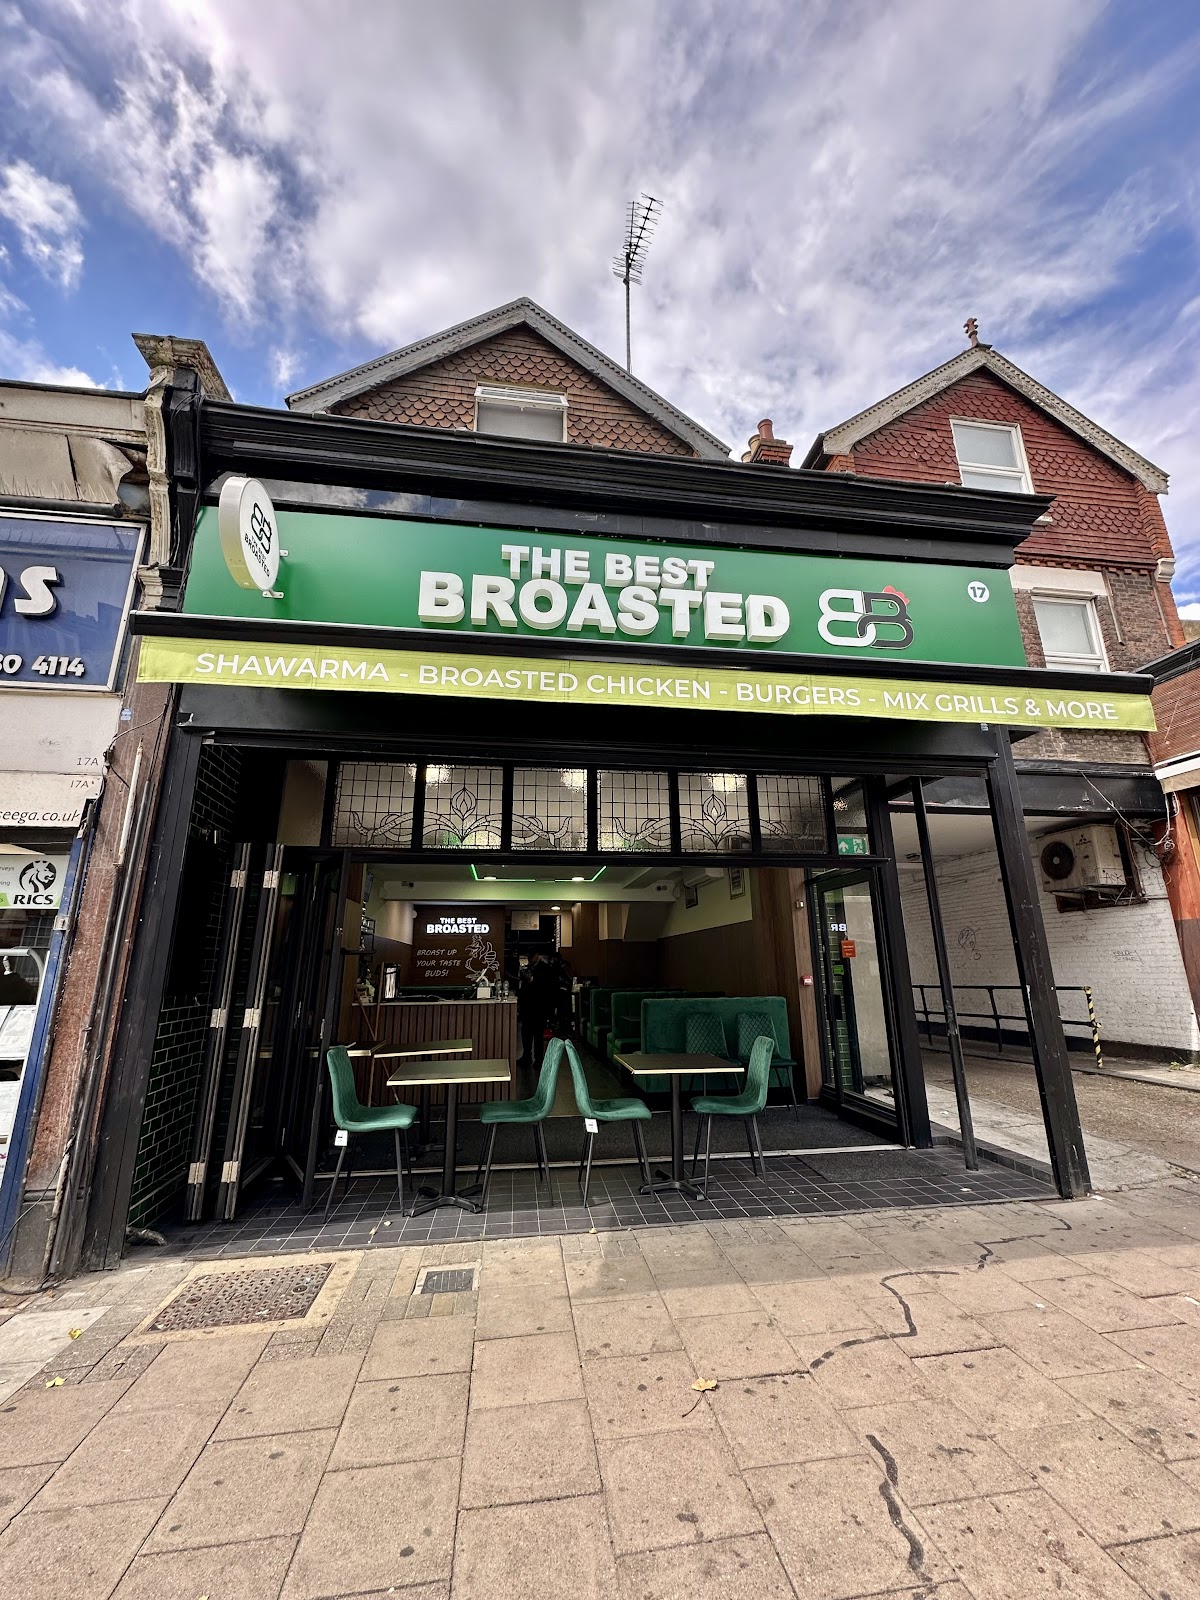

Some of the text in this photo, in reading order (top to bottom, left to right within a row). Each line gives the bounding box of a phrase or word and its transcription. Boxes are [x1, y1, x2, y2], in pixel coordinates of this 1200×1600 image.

[501, 544, 715, 591] THE BEST
[0, 565, 60, 616] S
[970, 586, 986, 599] 17
[418, 570, 790, 643] BROASTED
[0, 653, 85, 677] 0 4114
[195, 652, 390, 682] SHAWARMA
[418, 664, 578, 692] BROASTED
[586, 673, 711, 699] CHICKEN
[736, 683, 861, 707] BURGERS
[883, 691, 930, 711] MIX
[935, 694, 1019, 716] GRILLS
[1025, 698, 1041, 717] &
[1047, 700, 1119, 720] MORE
[76, 757, 99, 766] 17A
[70, 780, 89, 789] 17A
[13, 894, 54, 905] RICS
[426, 924, 490, 933] BROASTED
[439, 959, 461, 967] TASTE
[425, 969, 449, 977] BUDS!
